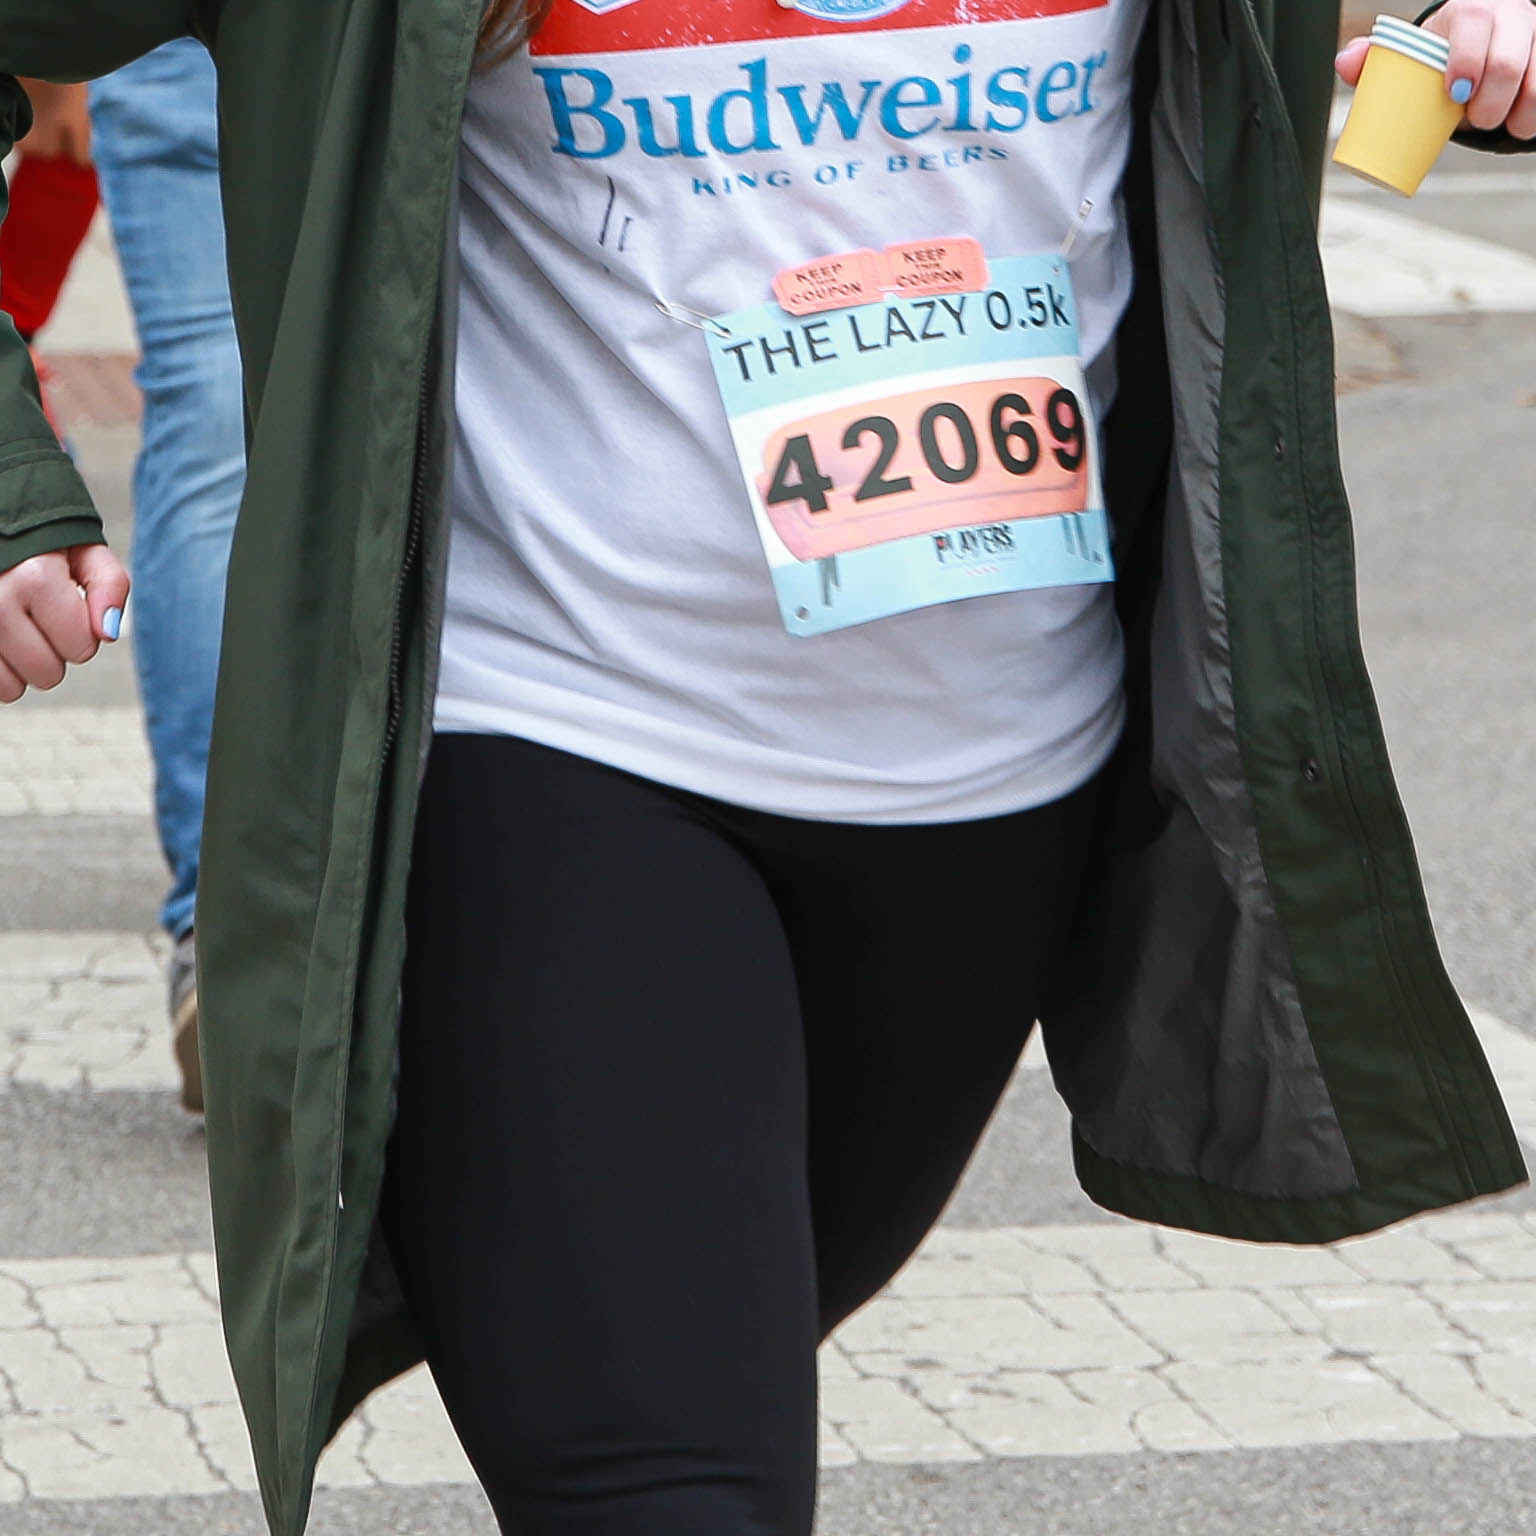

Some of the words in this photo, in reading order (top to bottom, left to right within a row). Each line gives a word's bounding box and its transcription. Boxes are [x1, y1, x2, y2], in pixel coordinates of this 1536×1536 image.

[532, 43, 1109, 161] Budweiser
[691, 169, 792, 196] KING
[813, 160, 864, 185] OF
[886, 145, 1010, 173] BEERS
[789, 281, 863, 305] COUPON
[895, 269, 964, 289] COUPON
[721, 319, 839, 382] THE
[847, 295, 968, 354] LAZY
[767, 387, 1086, 515] 42069
